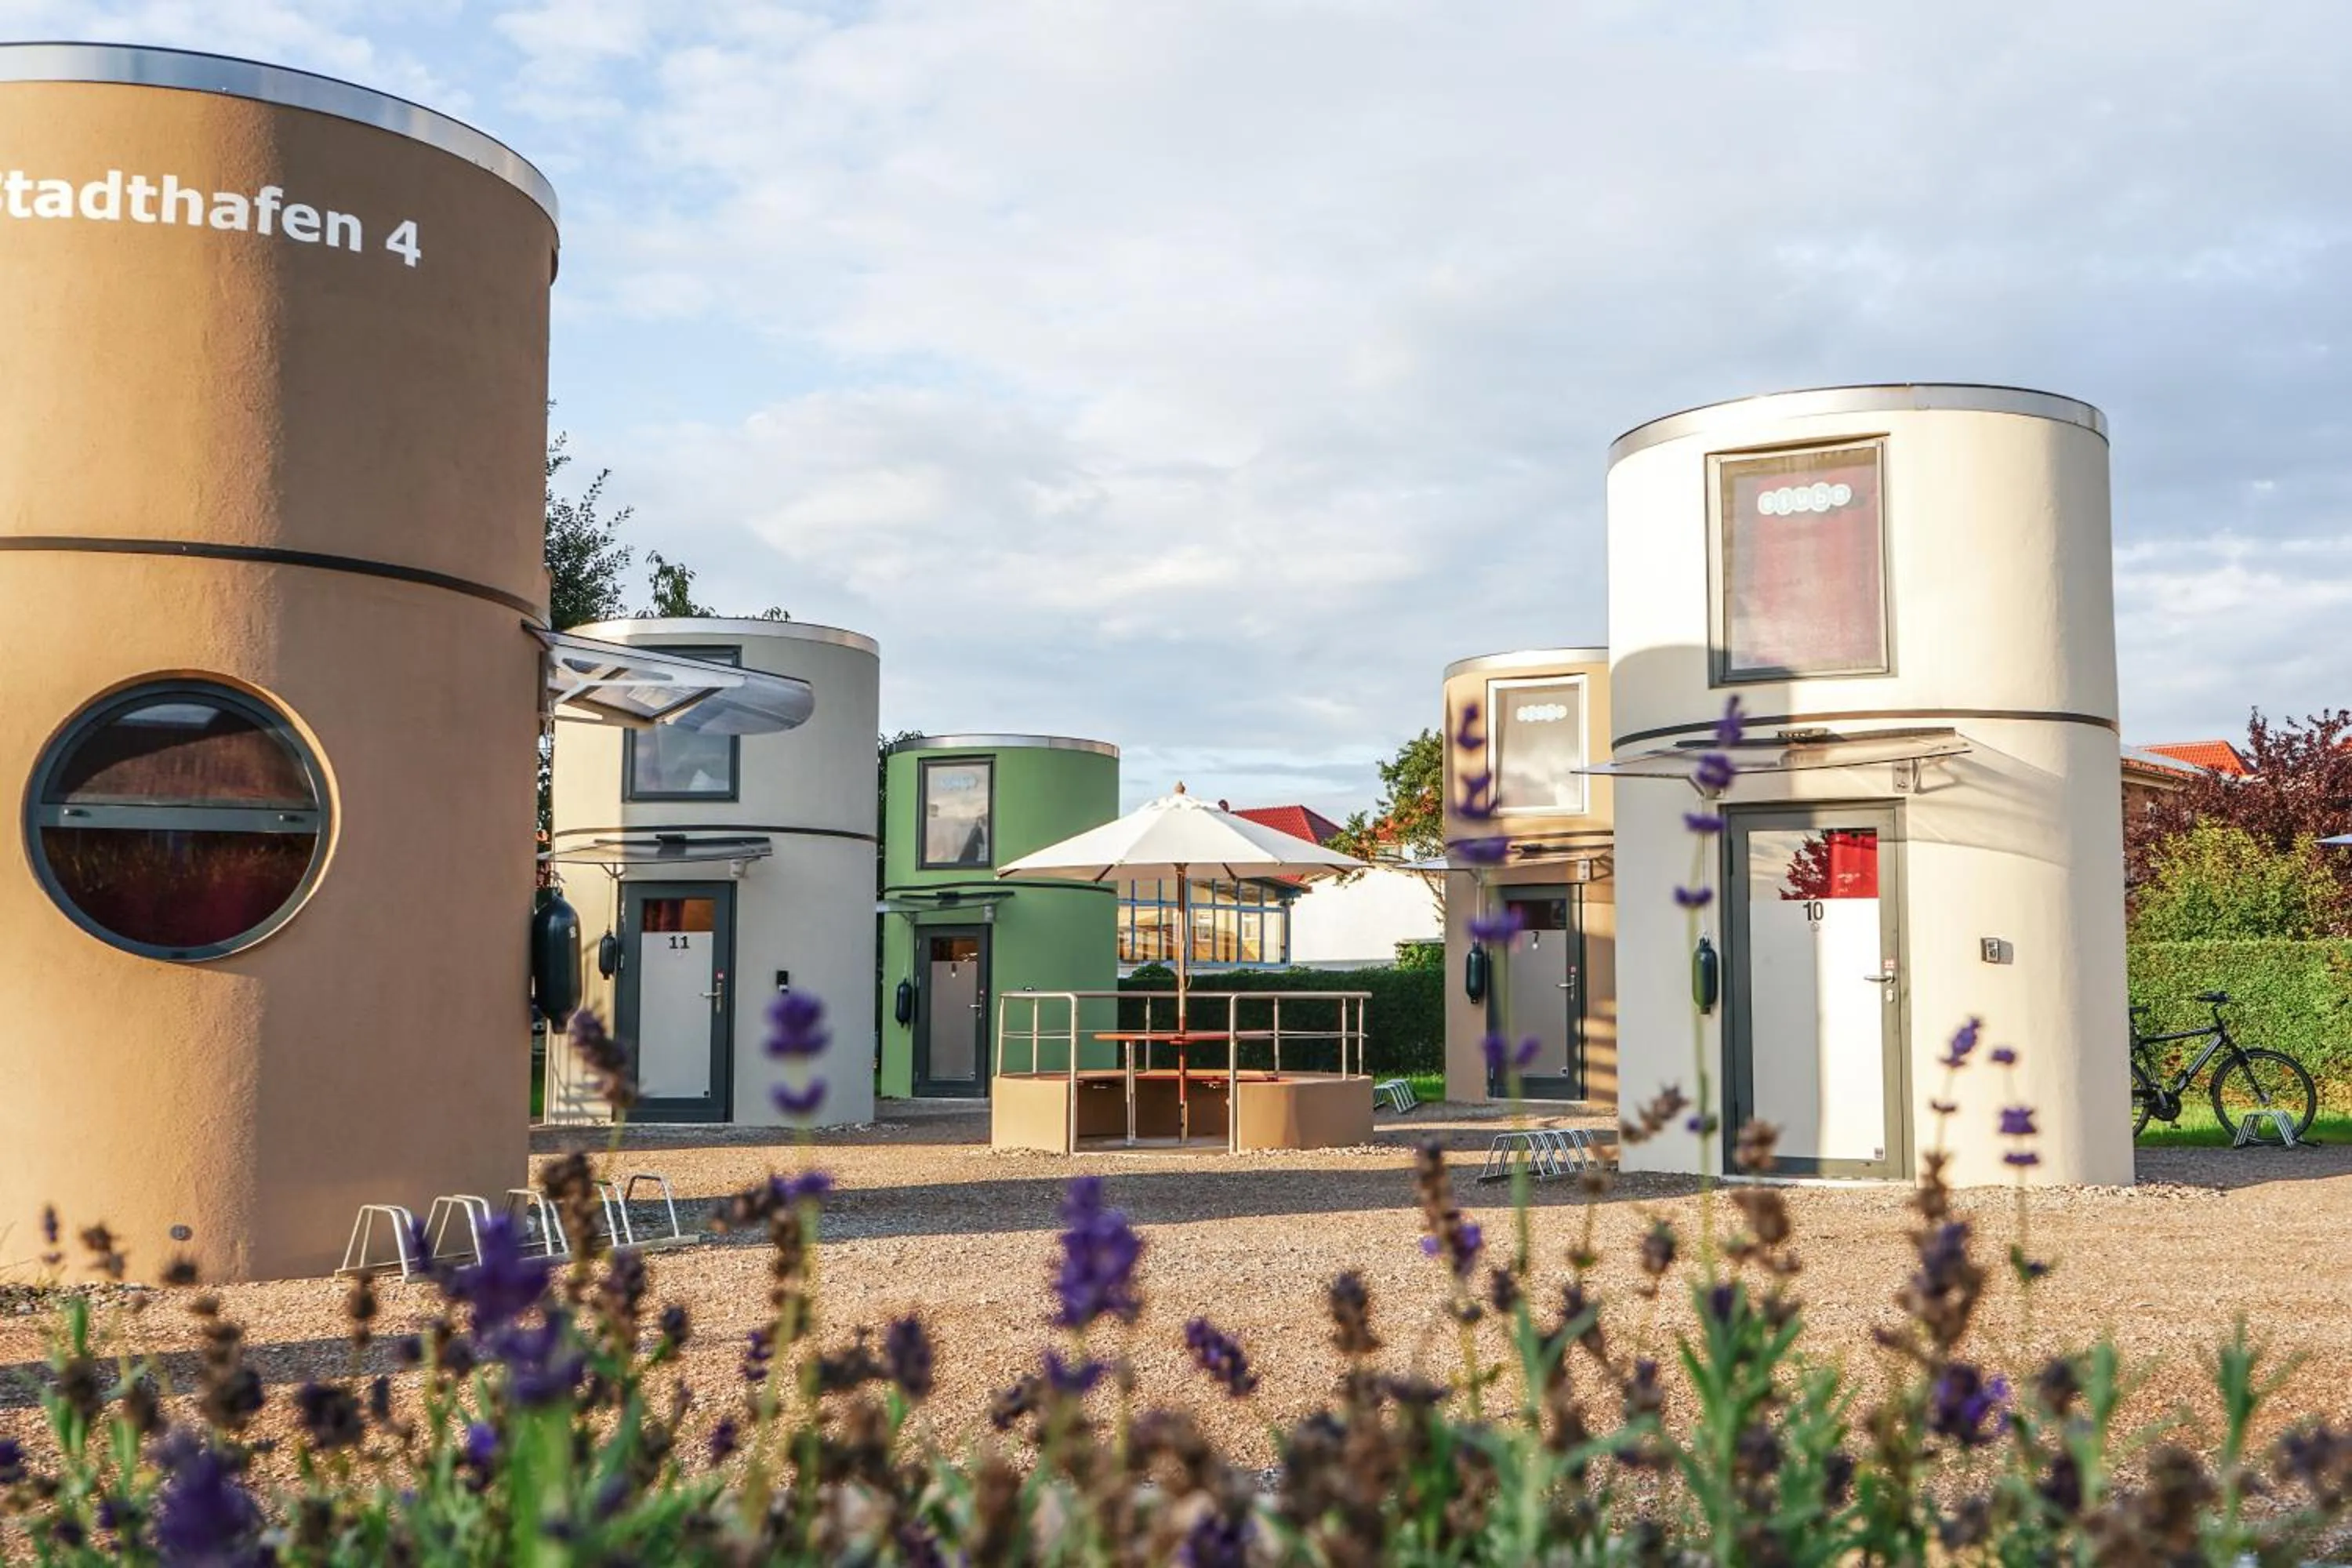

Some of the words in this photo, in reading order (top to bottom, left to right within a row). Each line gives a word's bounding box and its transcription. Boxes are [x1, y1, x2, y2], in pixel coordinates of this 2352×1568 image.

[0, 169, 362, 252] tadthafen
[385, 220, 422, 267] 4
[1802, 901, 1824, 920] 10
[669, 935, 691, 949] 11
[1532, 931, 1540, 943] 7
